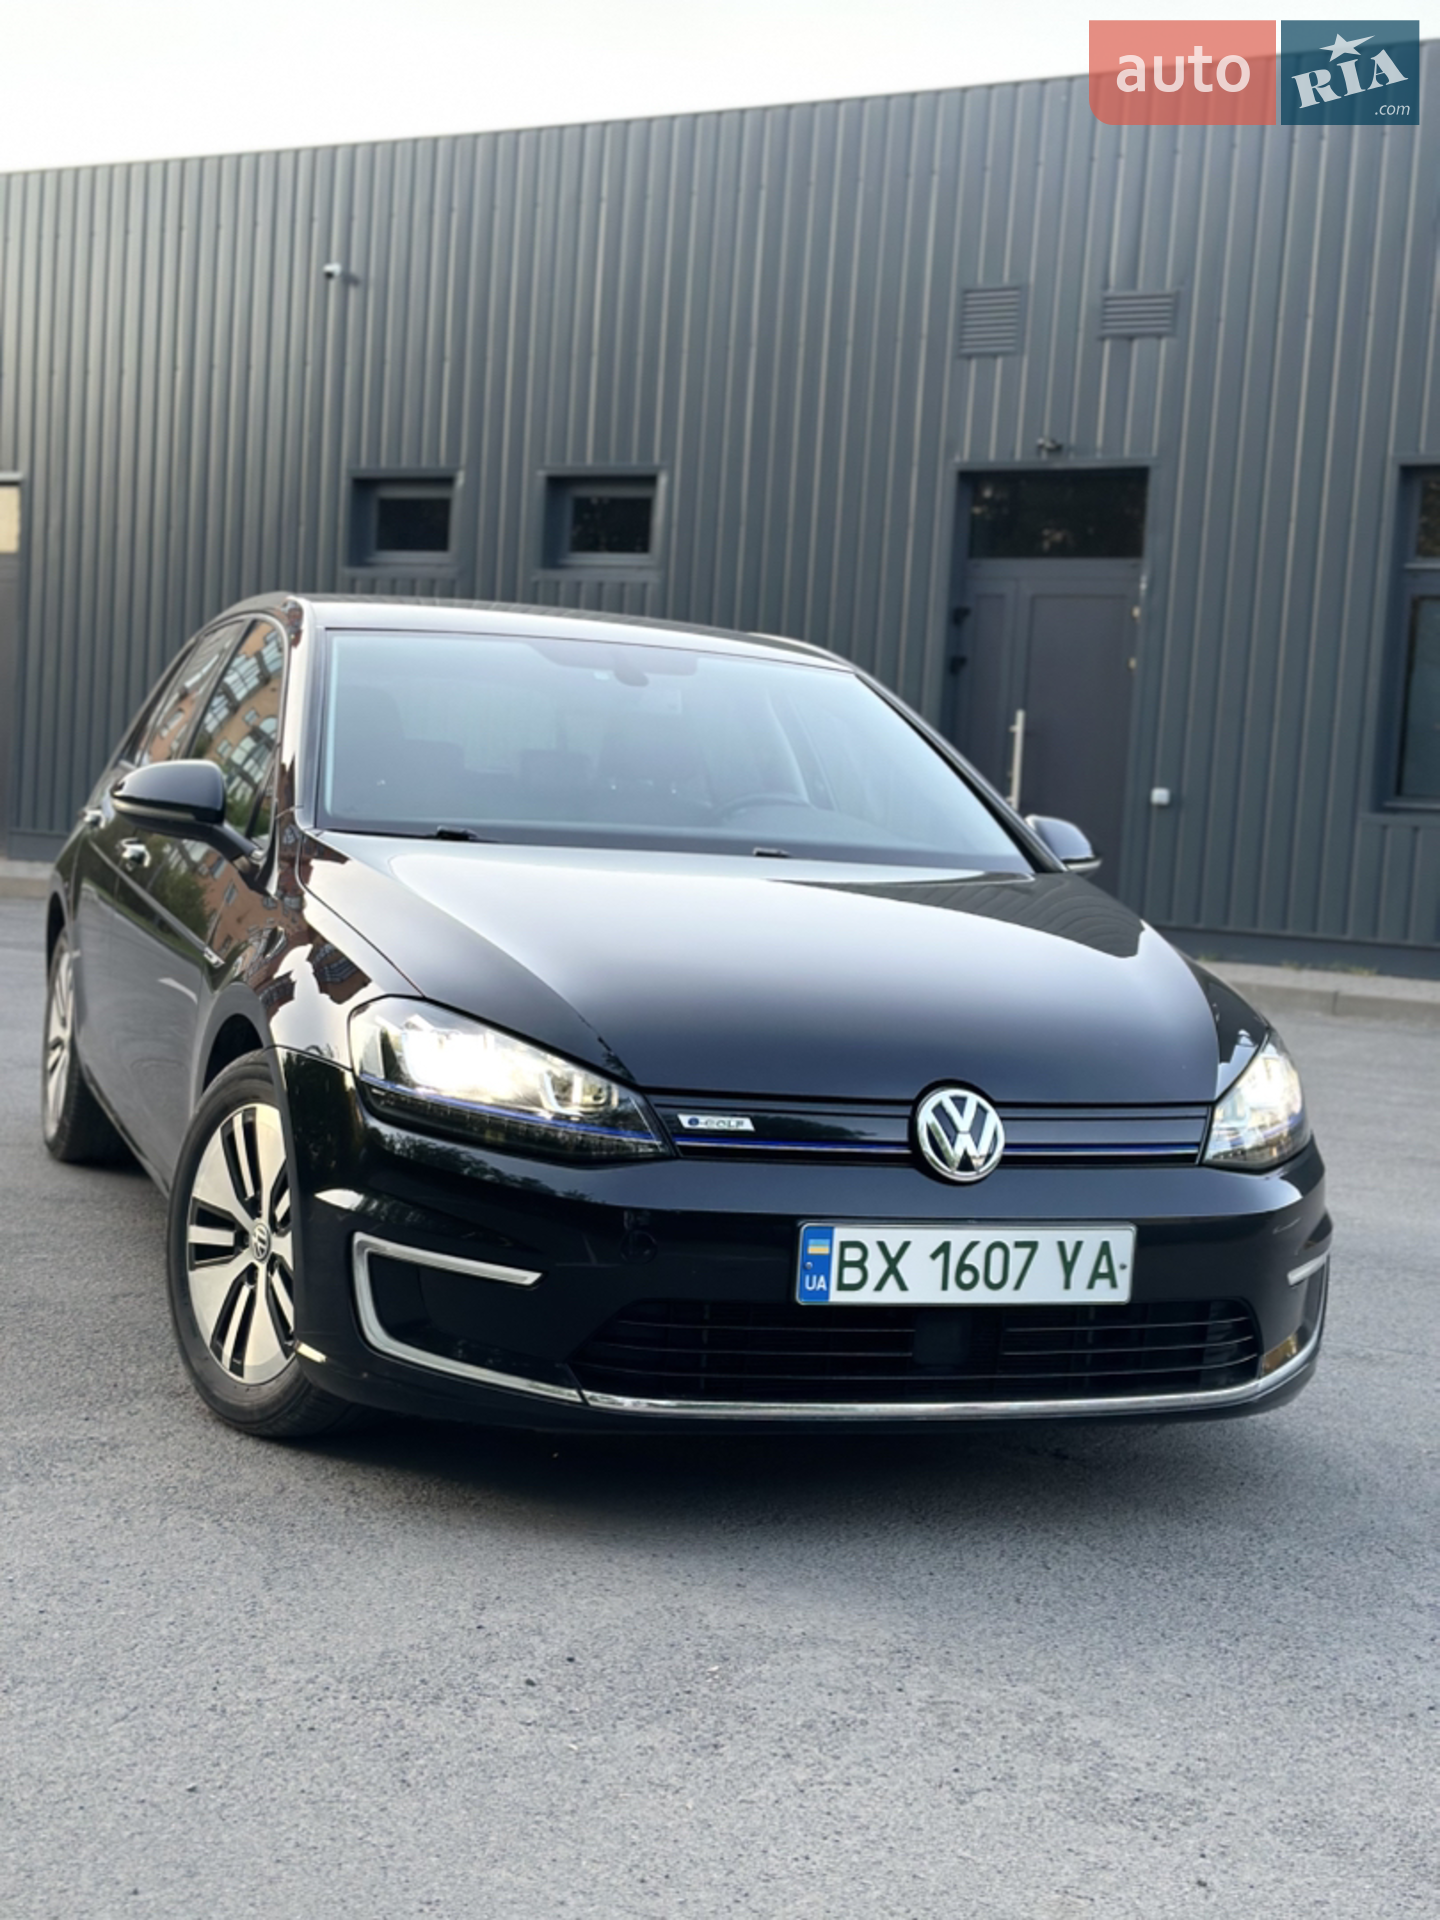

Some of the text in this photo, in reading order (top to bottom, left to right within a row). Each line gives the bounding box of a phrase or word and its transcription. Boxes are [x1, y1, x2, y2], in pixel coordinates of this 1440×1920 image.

[804, 1274, 827, 1291] UA
[836, 1240, 1119, 1292] BX 1607 YA
